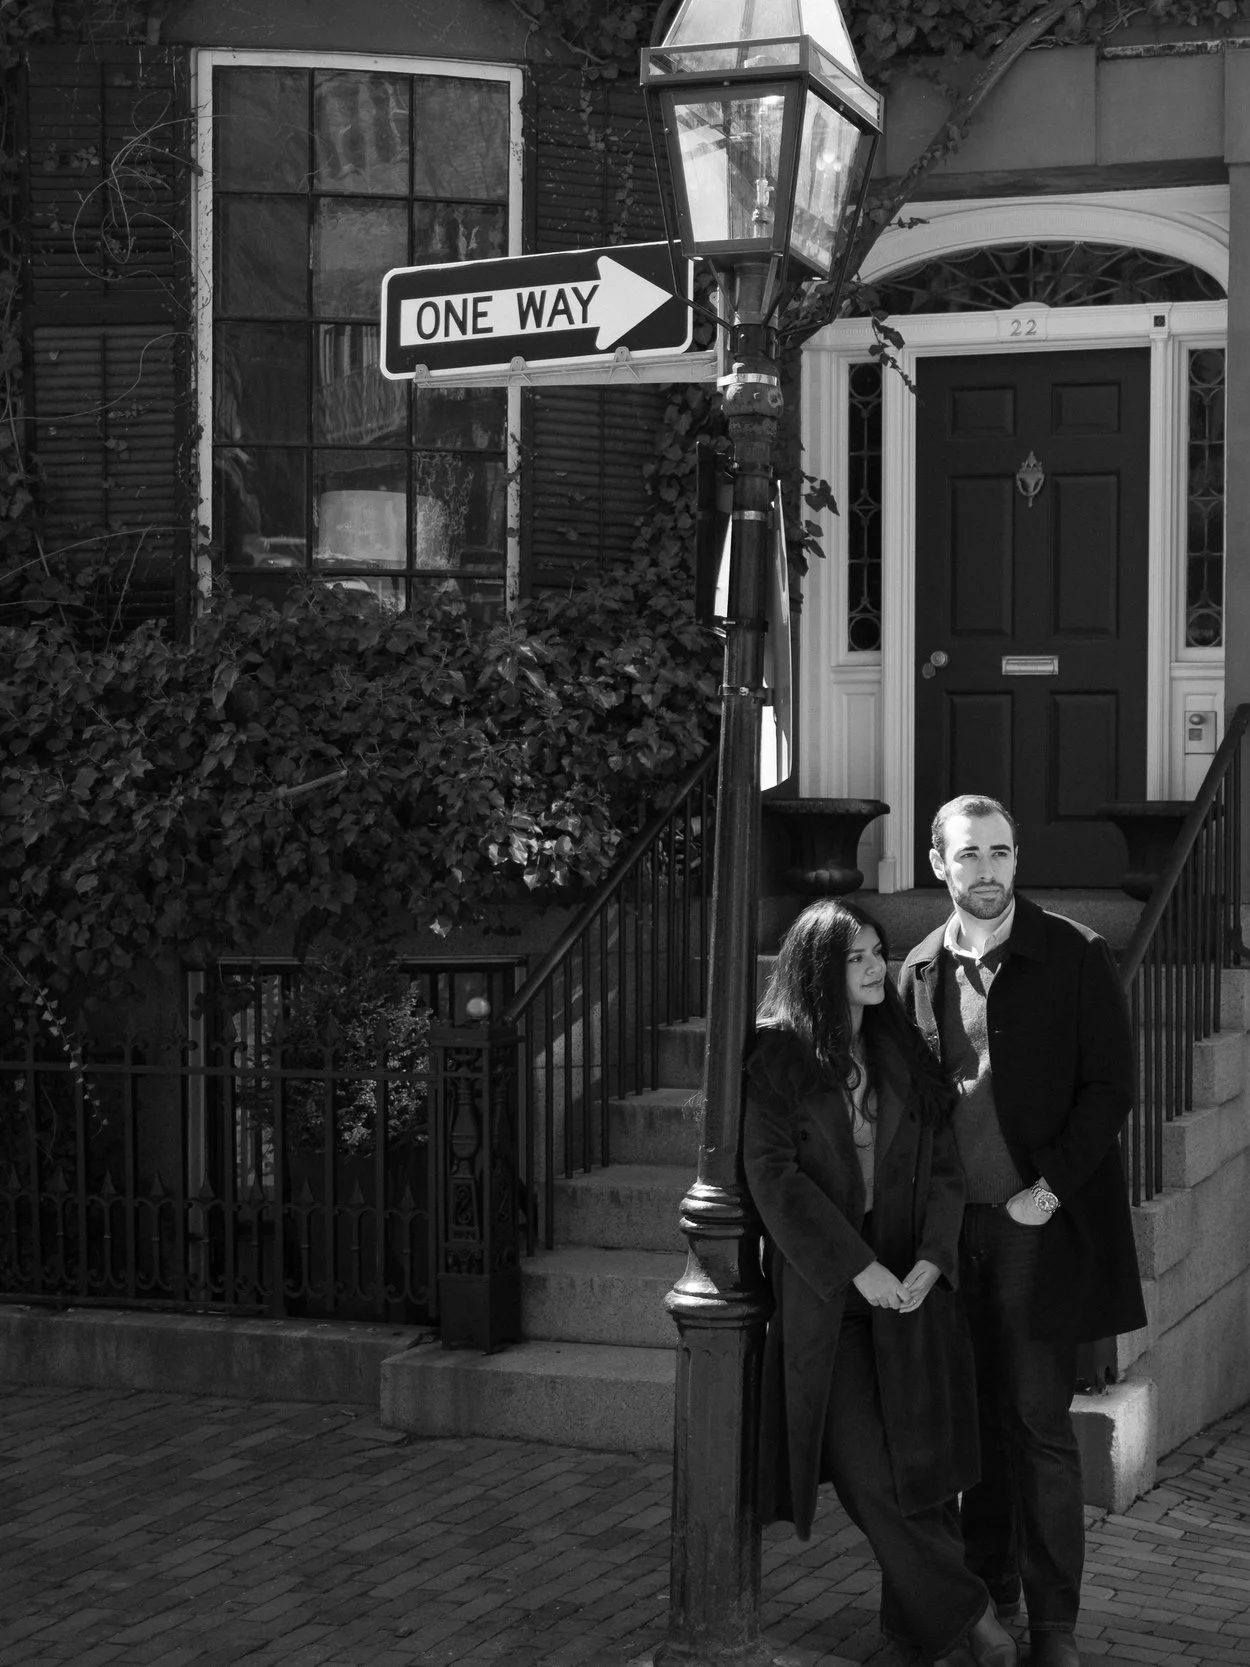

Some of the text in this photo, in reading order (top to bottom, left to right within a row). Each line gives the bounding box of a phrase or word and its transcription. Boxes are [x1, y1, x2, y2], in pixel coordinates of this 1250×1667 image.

[416, 285, 599, 340] ONE WAY
[1010, 319, 1037, 337] 22
